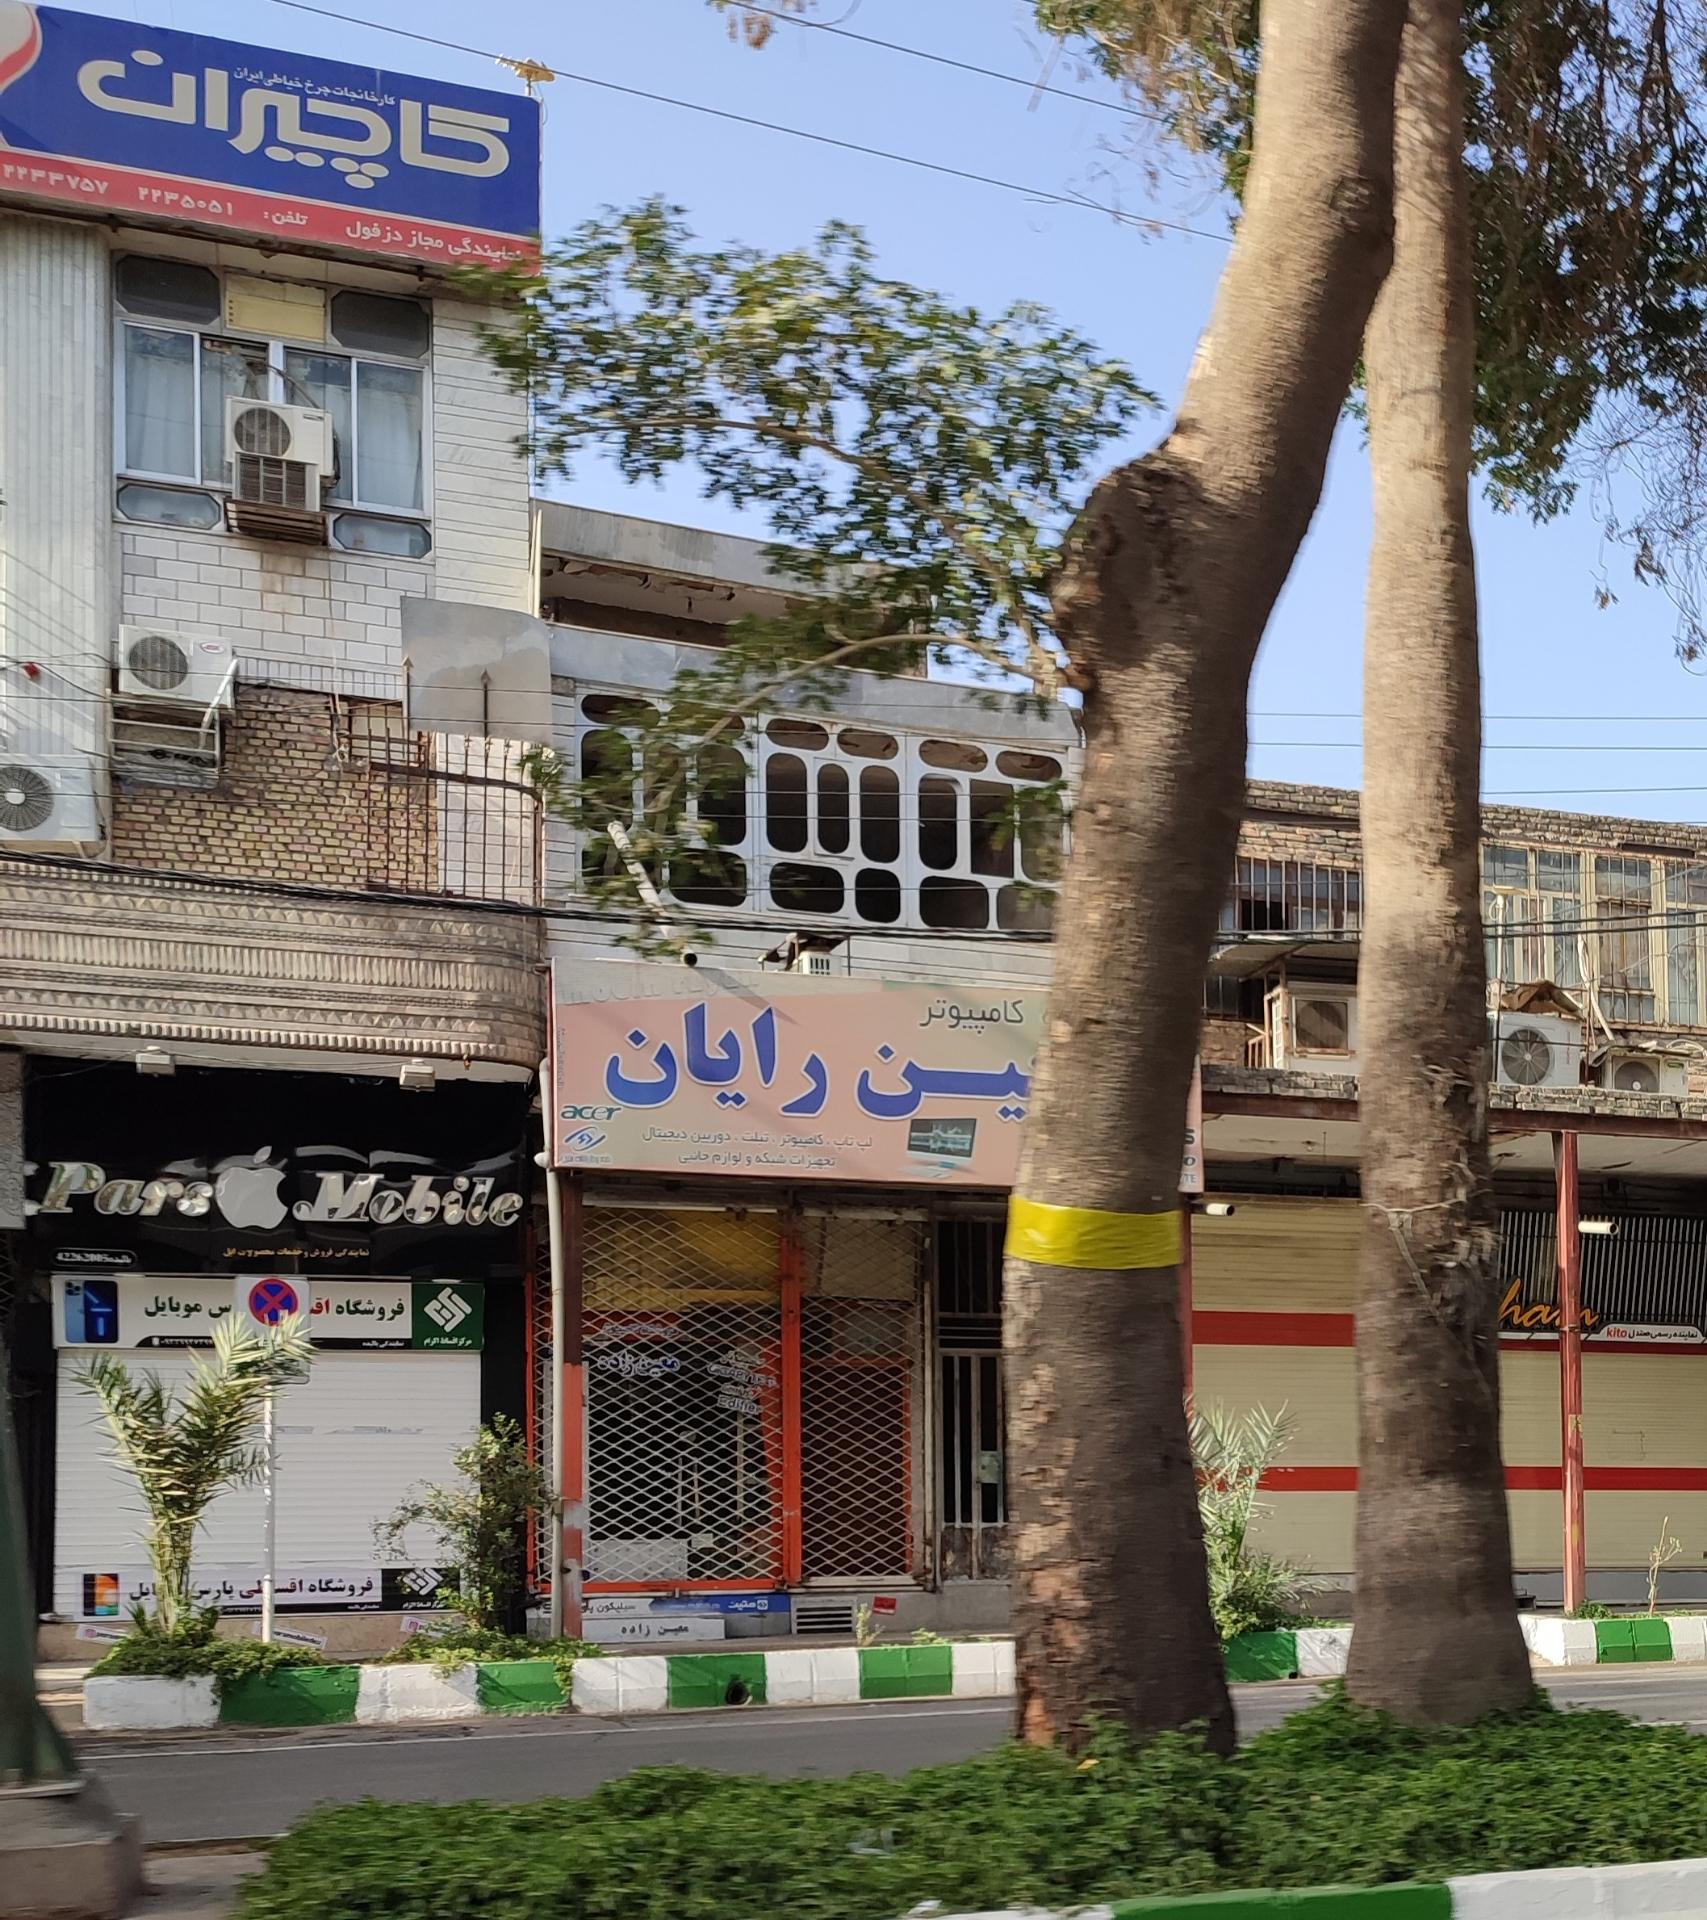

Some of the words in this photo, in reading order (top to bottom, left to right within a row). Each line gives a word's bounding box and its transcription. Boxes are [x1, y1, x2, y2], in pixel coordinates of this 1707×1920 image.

[234, 67, 263, 82] ایران
[263, 73, 303, 89] خیاطی
[304, 80, 332, 96] چرخ
[333, 87, 395, 106] کارخانجات
[77, 49, 510, 189] کاچیران
[407, 230, 444, 249] مجاز
[919, 999, 1024, 1034] کامپیوتر
[604, 1002, 830, 1117] رایان
[561, 1105, 621, 1121] acer
[711, 1151, 741, 1167] لوازم
[755, 1151, 785, 1166] شبکه
[39, 1161, 213, 1217] Pars
[292, 1171, 524, 1228] Mobile
[145, 1295, 203, 1318] موبایل
[335, 1297, 405, 1321] فروشگاه
[1606, 1327, 1628, 1338] kito
[1672, 1330, 1698, 1340] نماینده
[309, 1577, 373, 1598] فروشگاه
[597, 1601, 636, 1614] سیلیکون
[621, 1624, 650, 1636] زاده
[658, 1624, 689, 1636] معین
